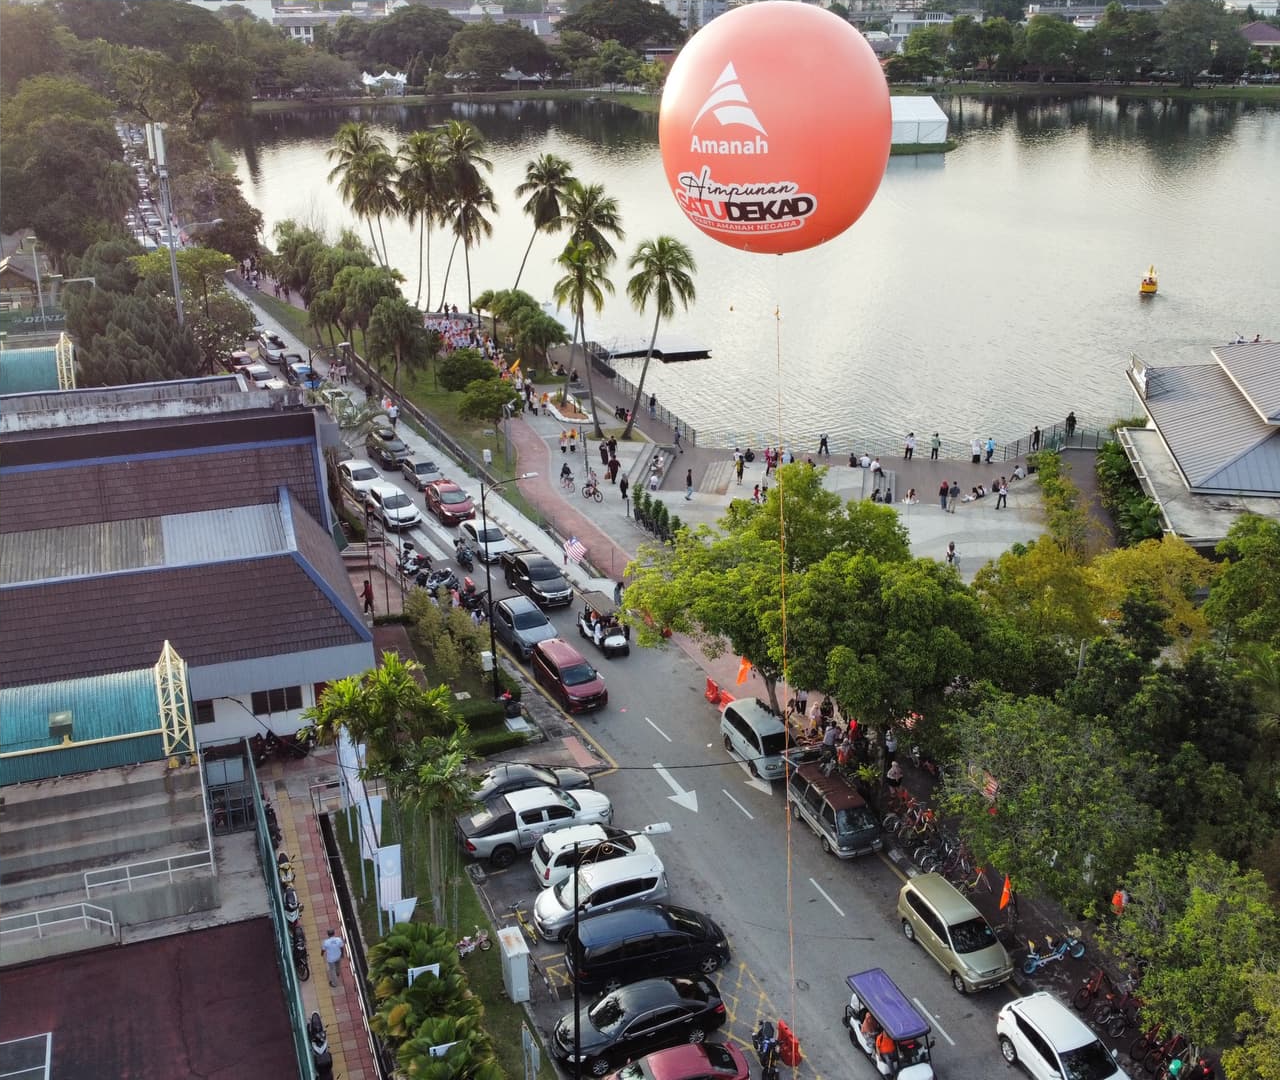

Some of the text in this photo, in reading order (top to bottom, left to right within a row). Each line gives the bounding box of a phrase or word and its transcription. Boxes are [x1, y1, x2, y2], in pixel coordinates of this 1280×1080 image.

[691, 136, 769, 155] Amanah
[680, 169, 794, 204] Himpunan
[757, 220, 798, 232] NEGARA
